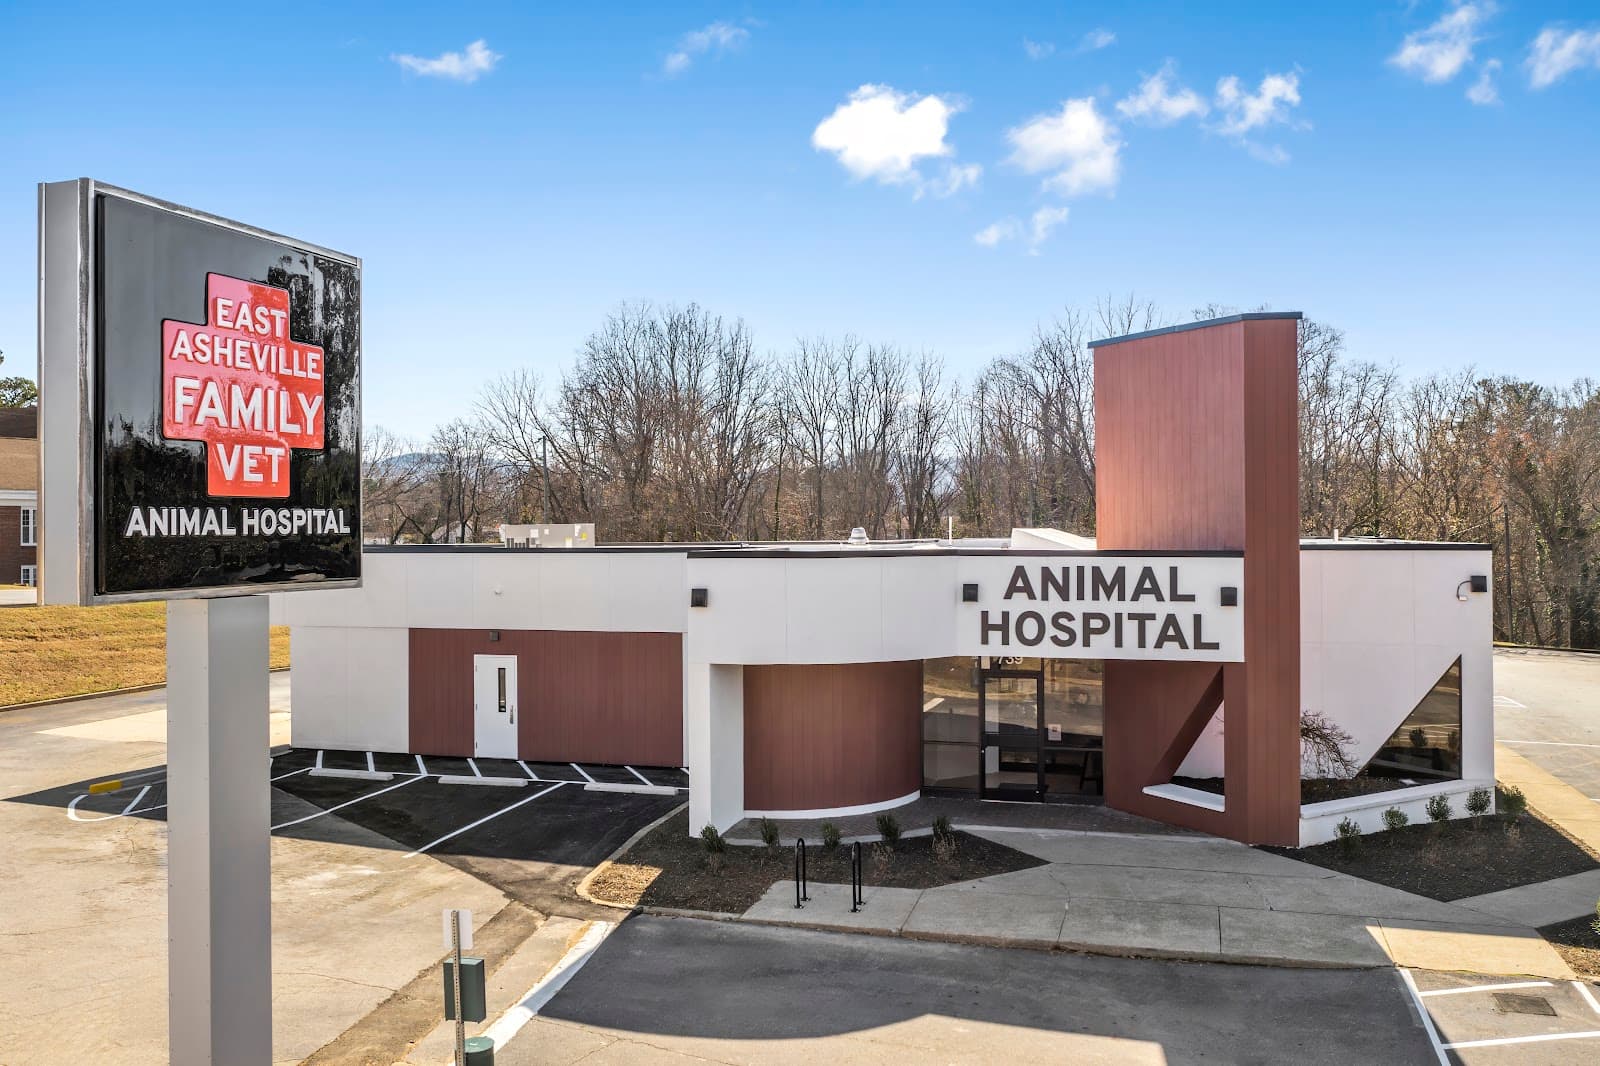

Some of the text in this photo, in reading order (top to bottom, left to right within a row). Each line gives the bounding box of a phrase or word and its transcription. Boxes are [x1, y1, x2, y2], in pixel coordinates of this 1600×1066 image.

[216, 297, 287, 337] EAST
[170, 331, 322, 380] ASHEVILLE
[174, 377, 324, 435] FAMILY
[217, 443, 286, 483] VET
[125, 507, 351, 537] ANIMAL HOSPITAL
[1003, 565, 1196, 602] ANIMAL
[981, 610, 1220, 650] HOSPITAL
